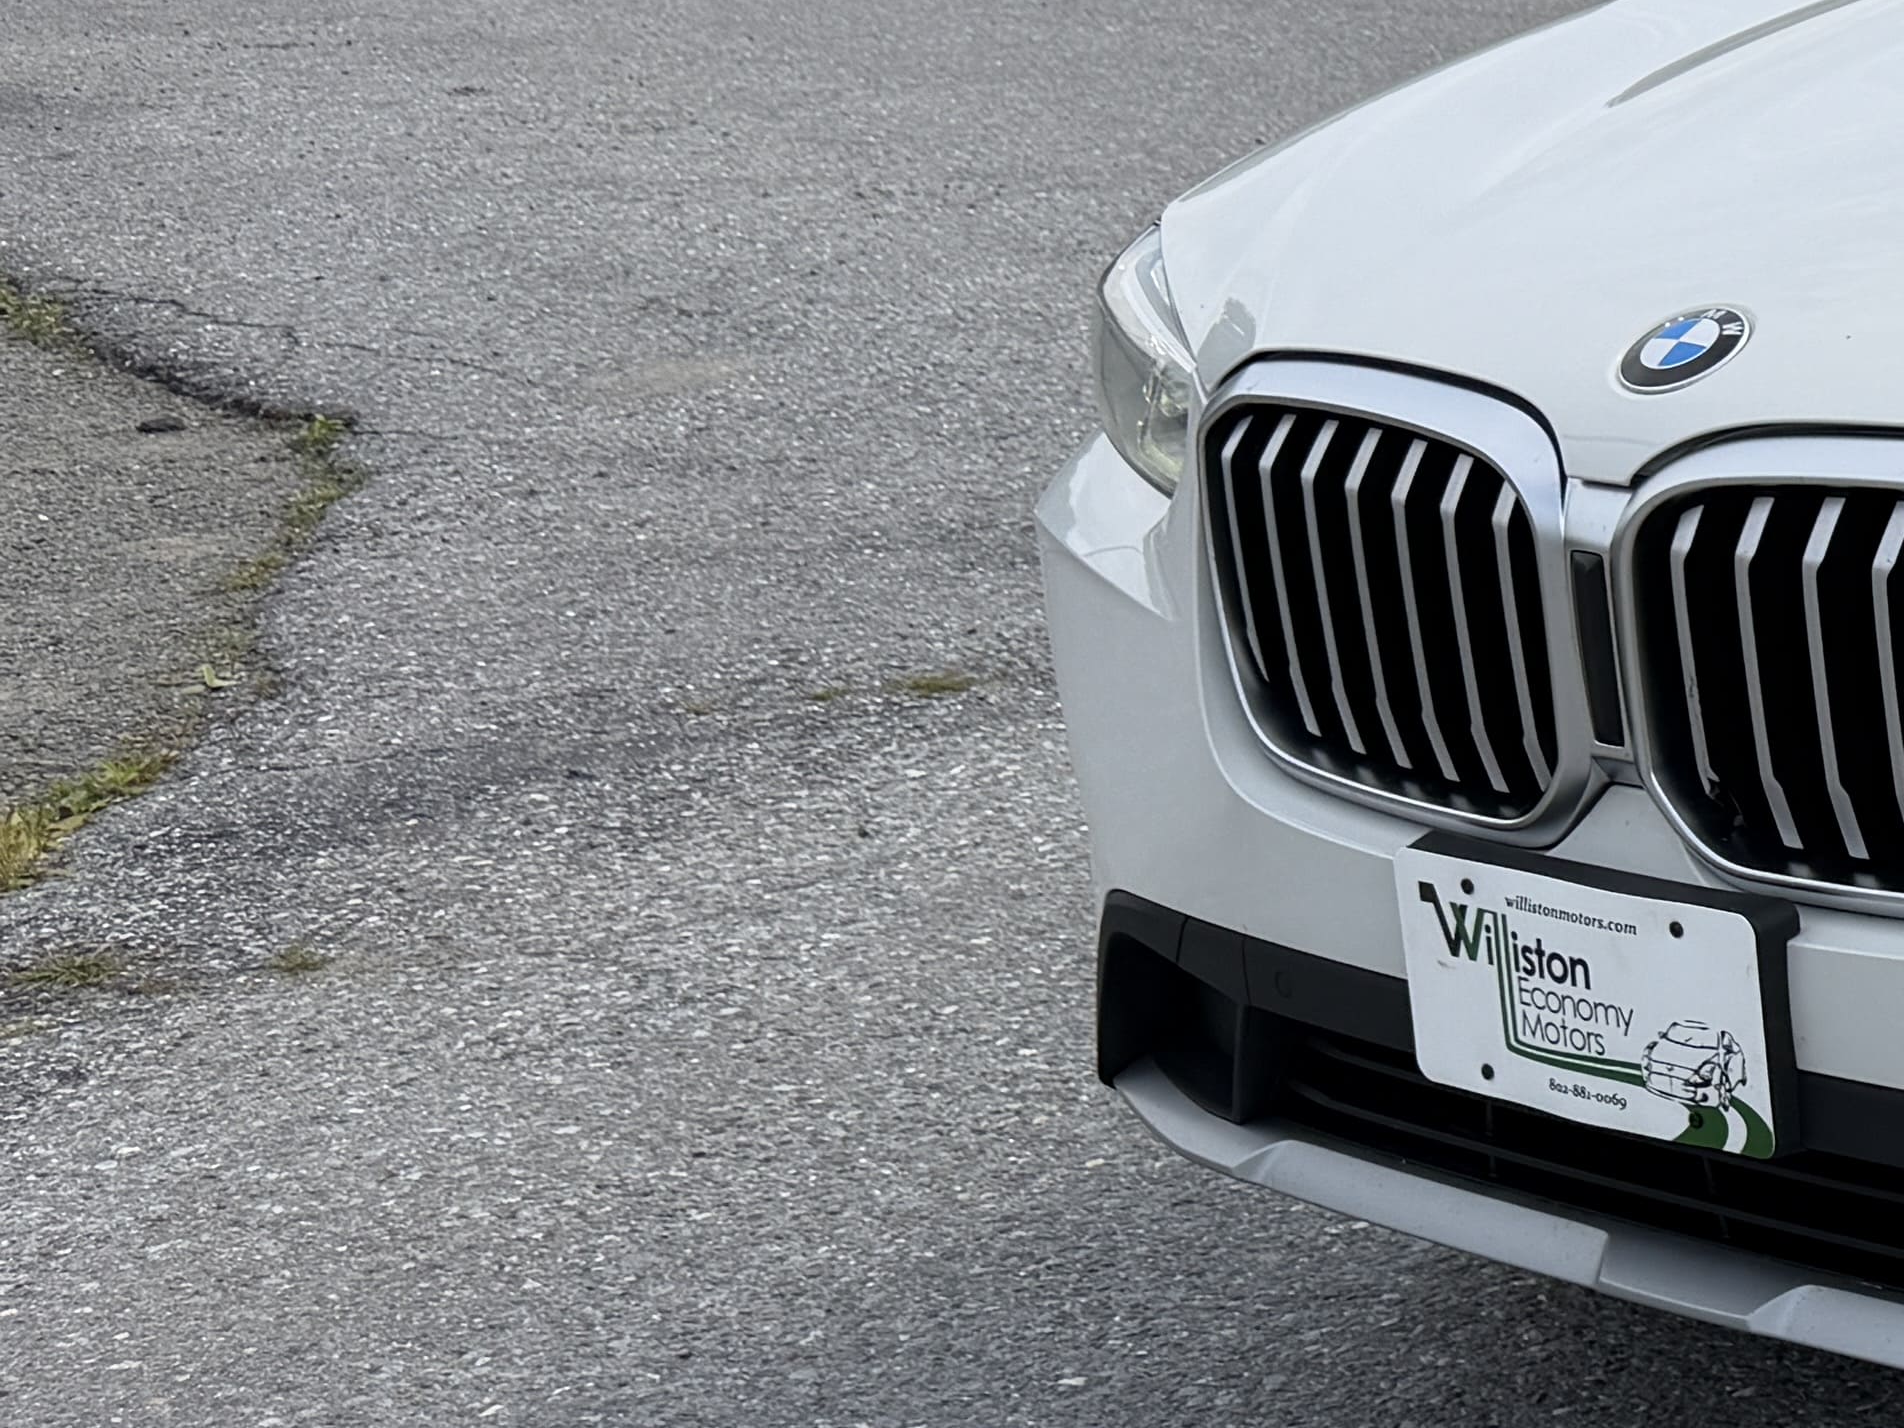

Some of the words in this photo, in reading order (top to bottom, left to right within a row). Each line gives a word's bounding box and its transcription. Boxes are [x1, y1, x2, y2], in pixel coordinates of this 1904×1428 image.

[1418, 880, 1592, 990] Williston
[1504, 895, 1637, 934] willistonmotors.com
[1518, 976, 1634, 1037] Economy
[1522, 1009, 1606, 1056] Motors
[1548, 1077, 1628, 1111] 802-881-0069
